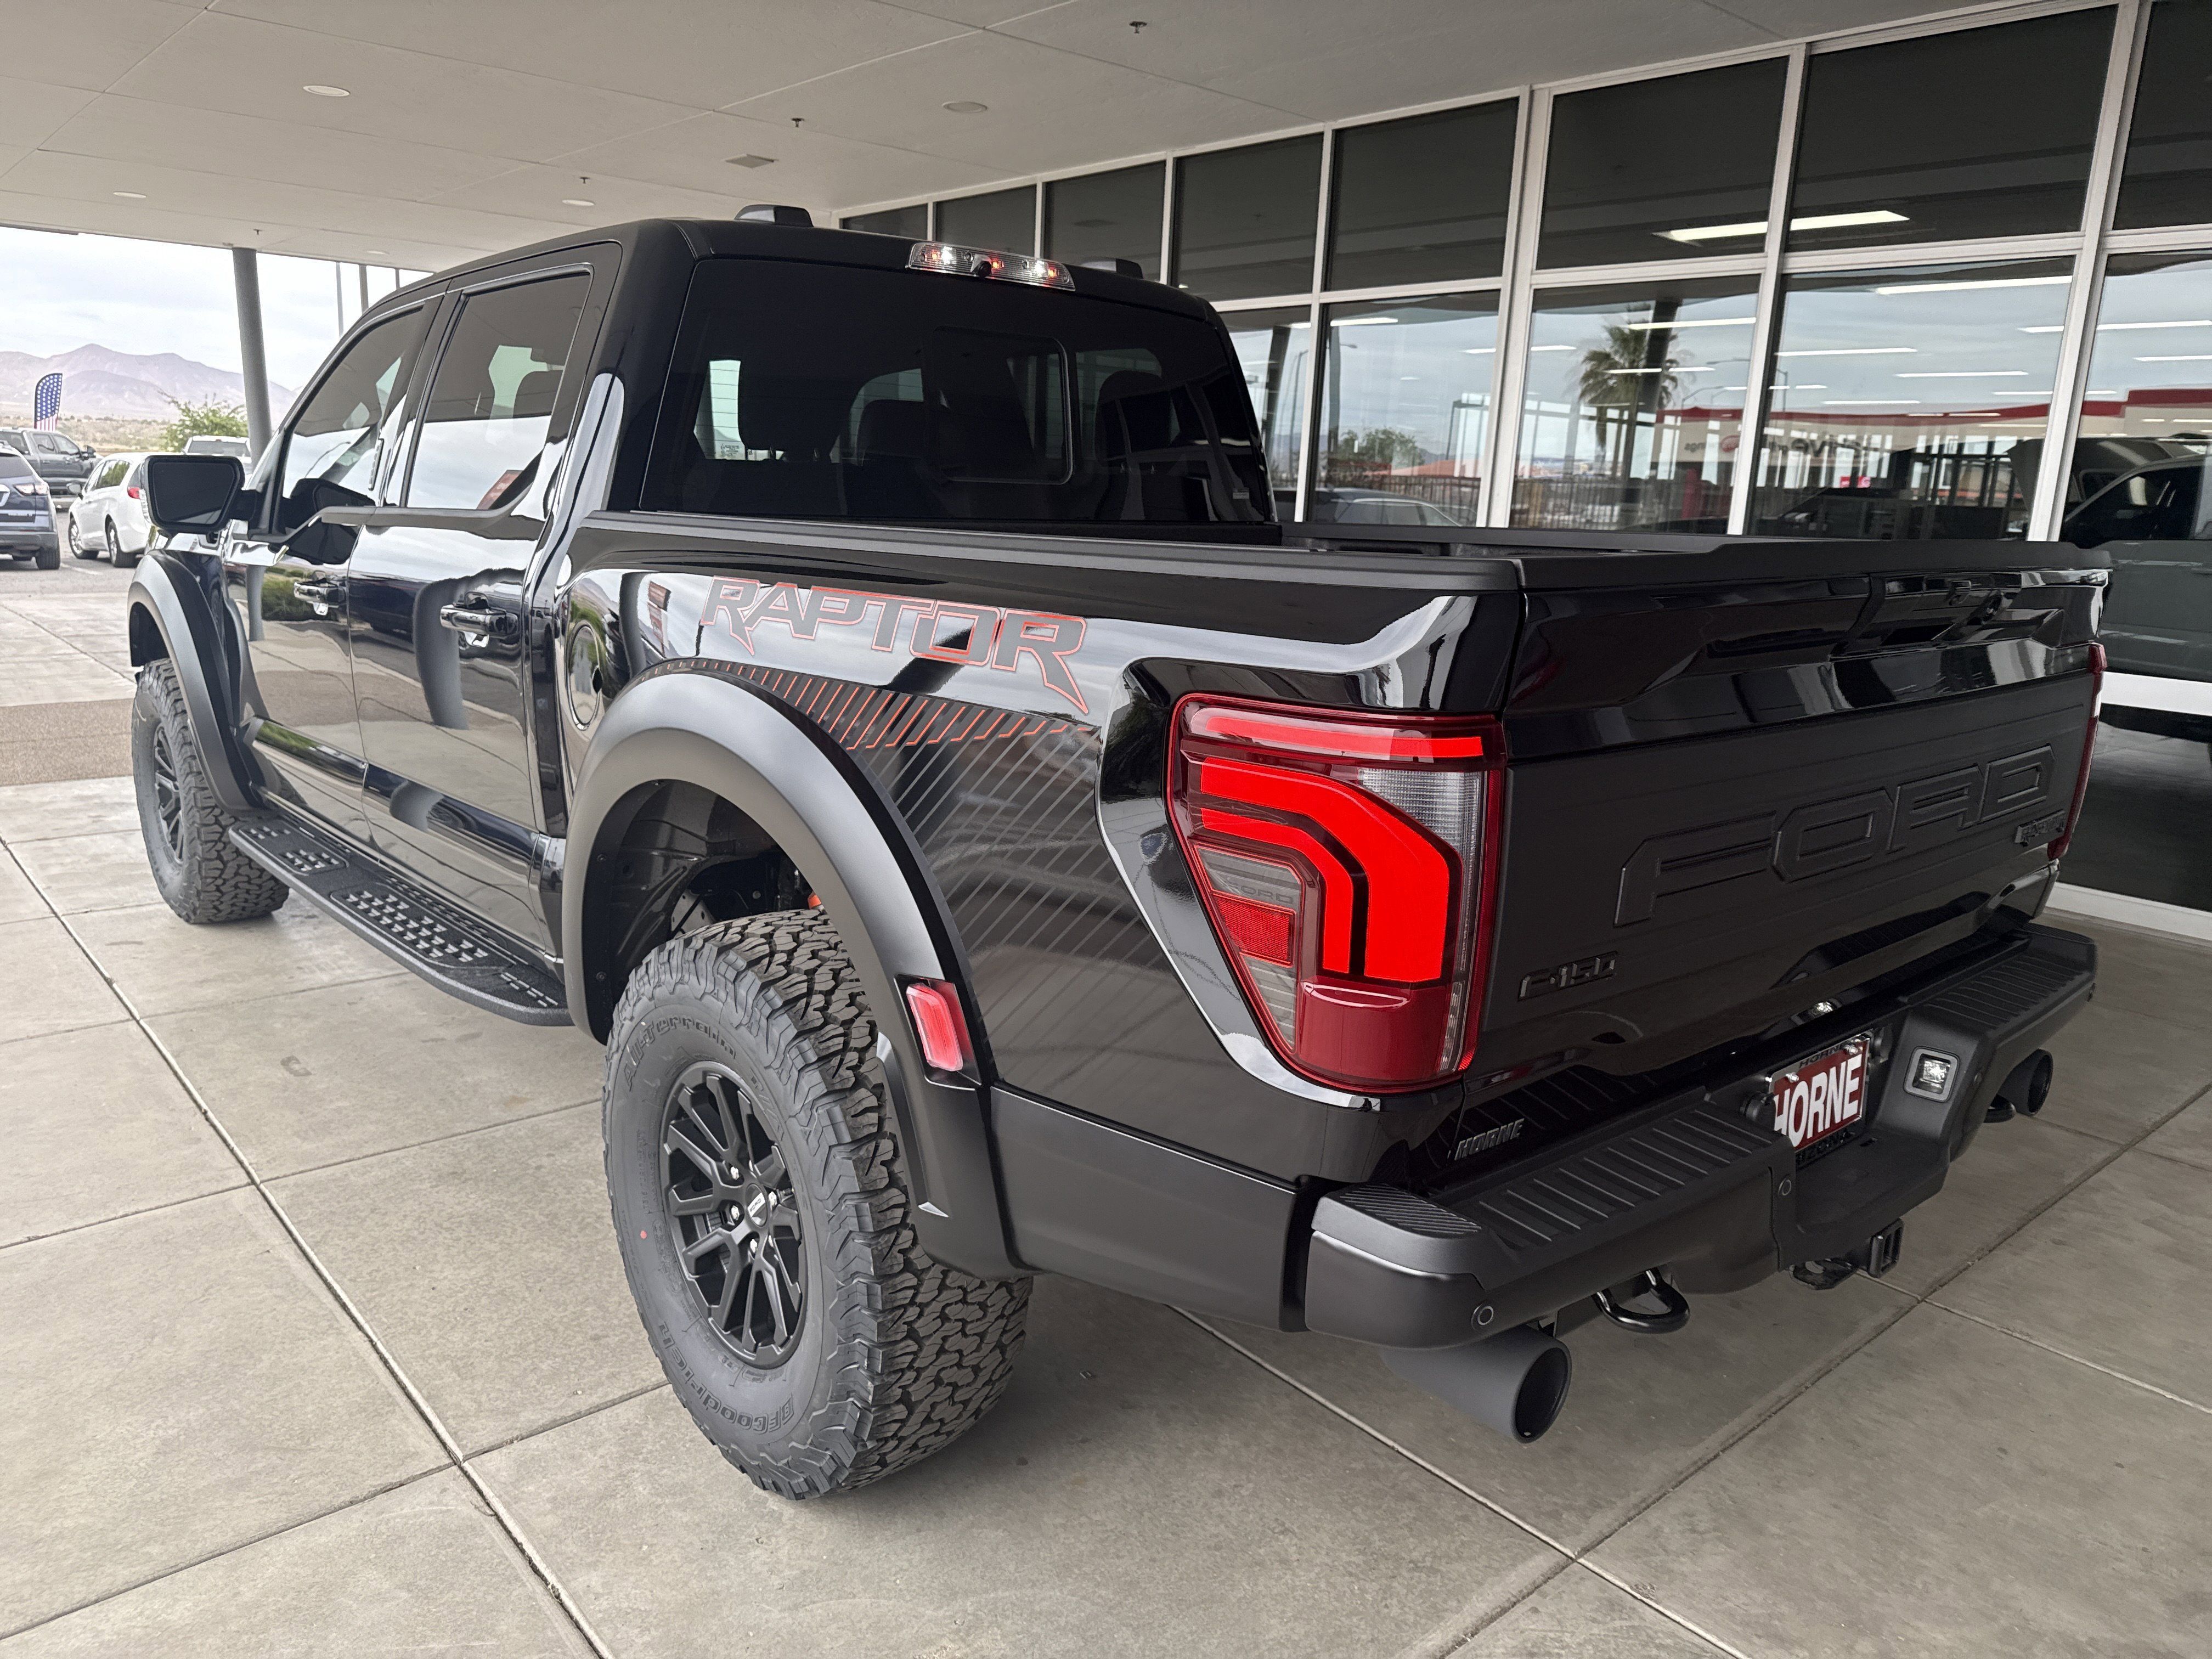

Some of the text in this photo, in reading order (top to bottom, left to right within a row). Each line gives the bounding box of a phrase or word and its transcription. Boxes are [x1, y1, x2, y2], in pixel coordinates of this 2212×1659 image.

[700, 575, 1089, 715] RAPTOR
[1614, 743, 2056, 927] FORD
[1227, 879, 1294, 905] FORD
[623, 1014, 737, 1093] All-Terrain
[1773, 1053, 1862, 1147] HORNE
[1454, 1118, 1525, 1161] HORNE
[657, 1321, 795, 1435] BFGoodrich
